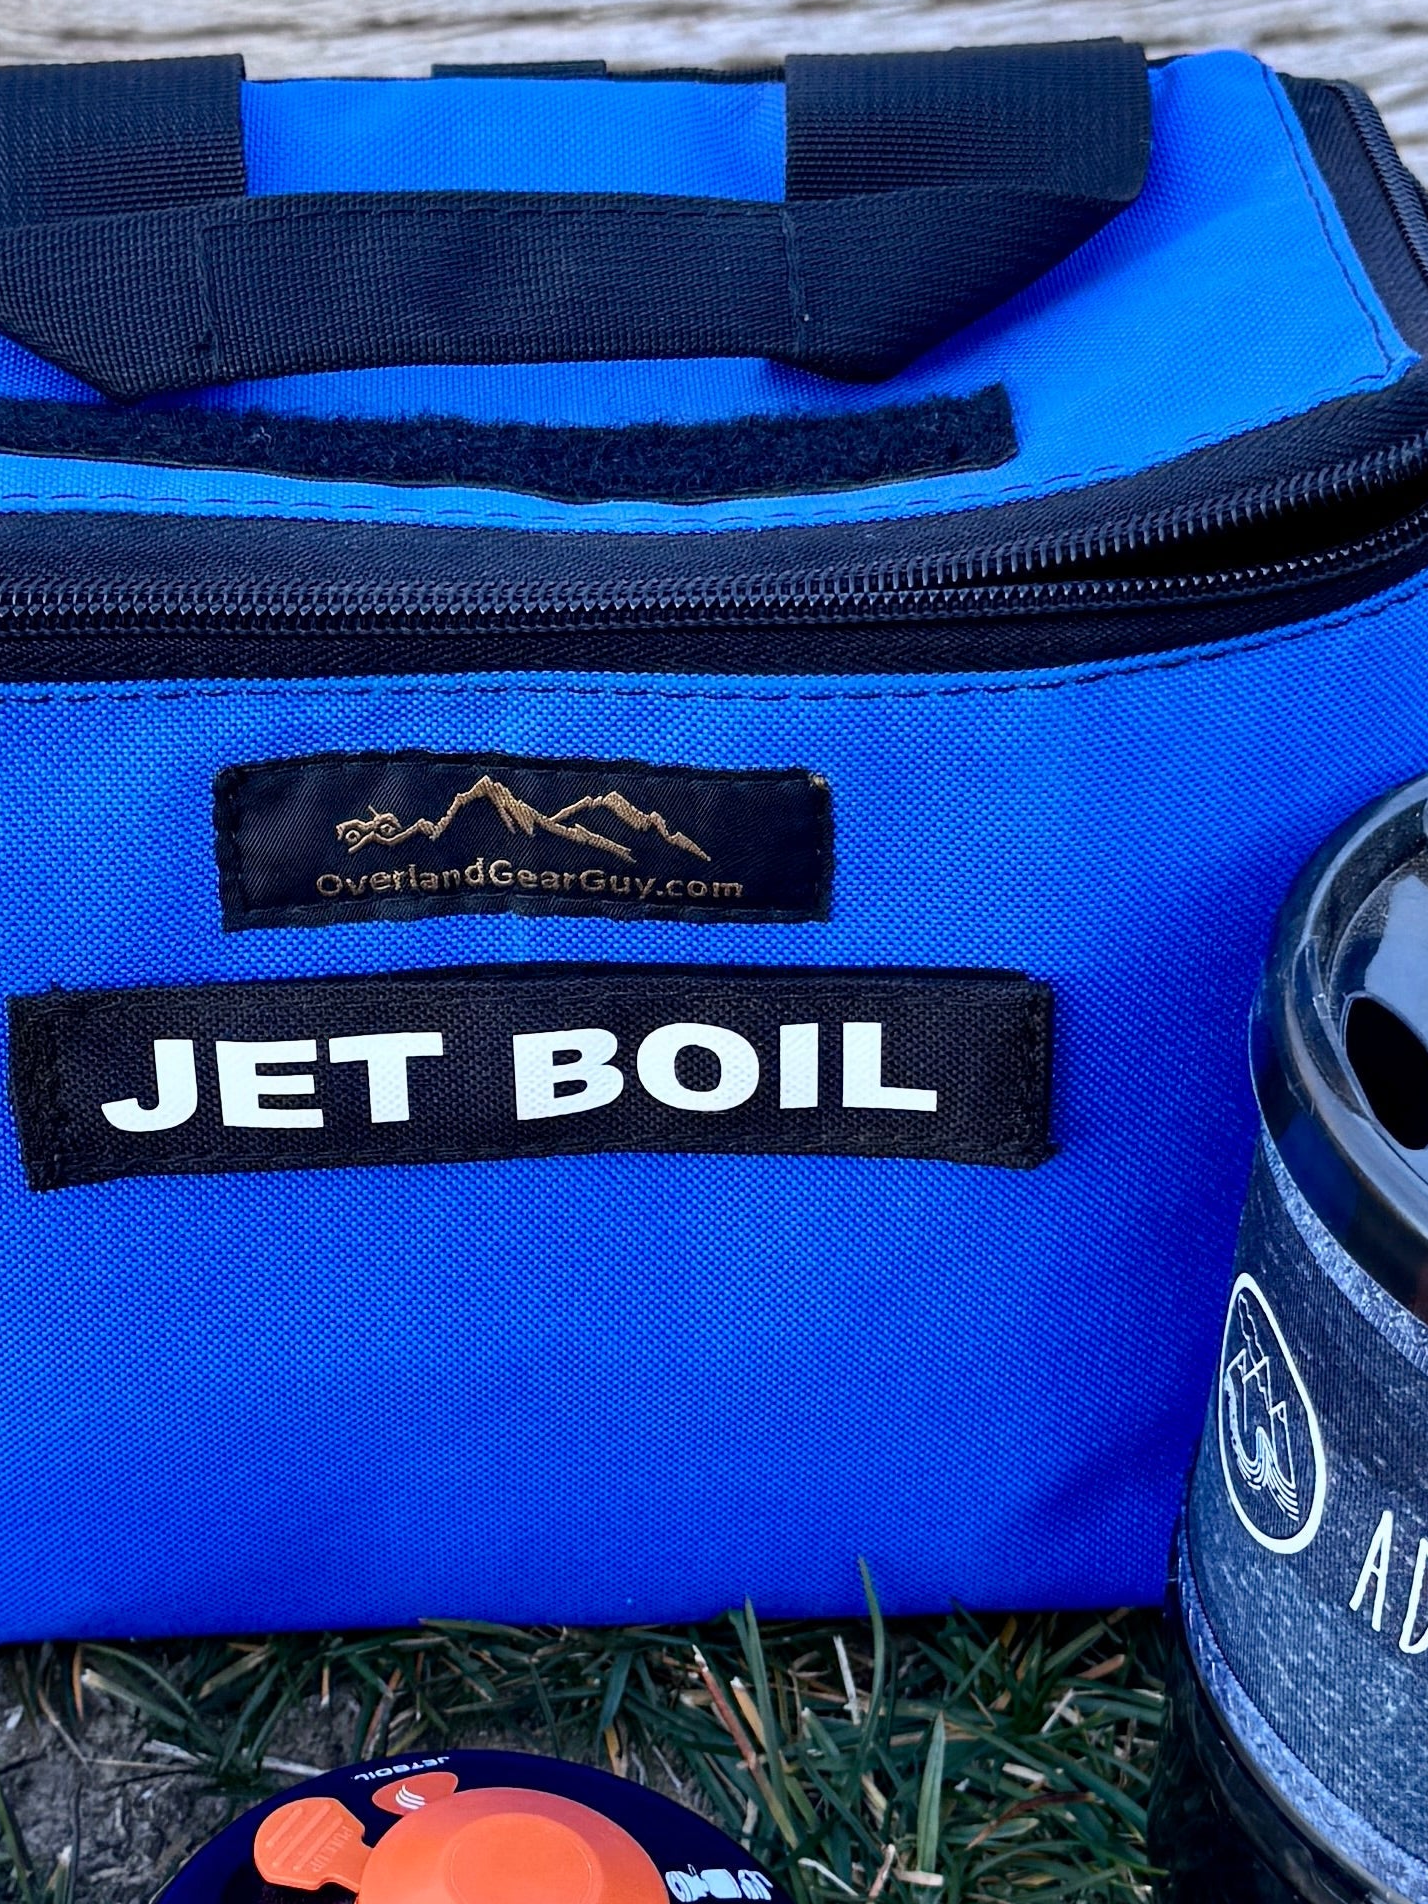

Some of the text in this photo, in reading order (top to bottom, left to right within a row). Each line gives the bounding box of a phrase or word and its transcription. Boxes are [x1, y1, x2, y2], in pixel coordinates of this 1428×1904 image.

[316, 857, 744, 900] OverlandGearGuy.com
[101, 1021, 938, 1132] JET BOIL
